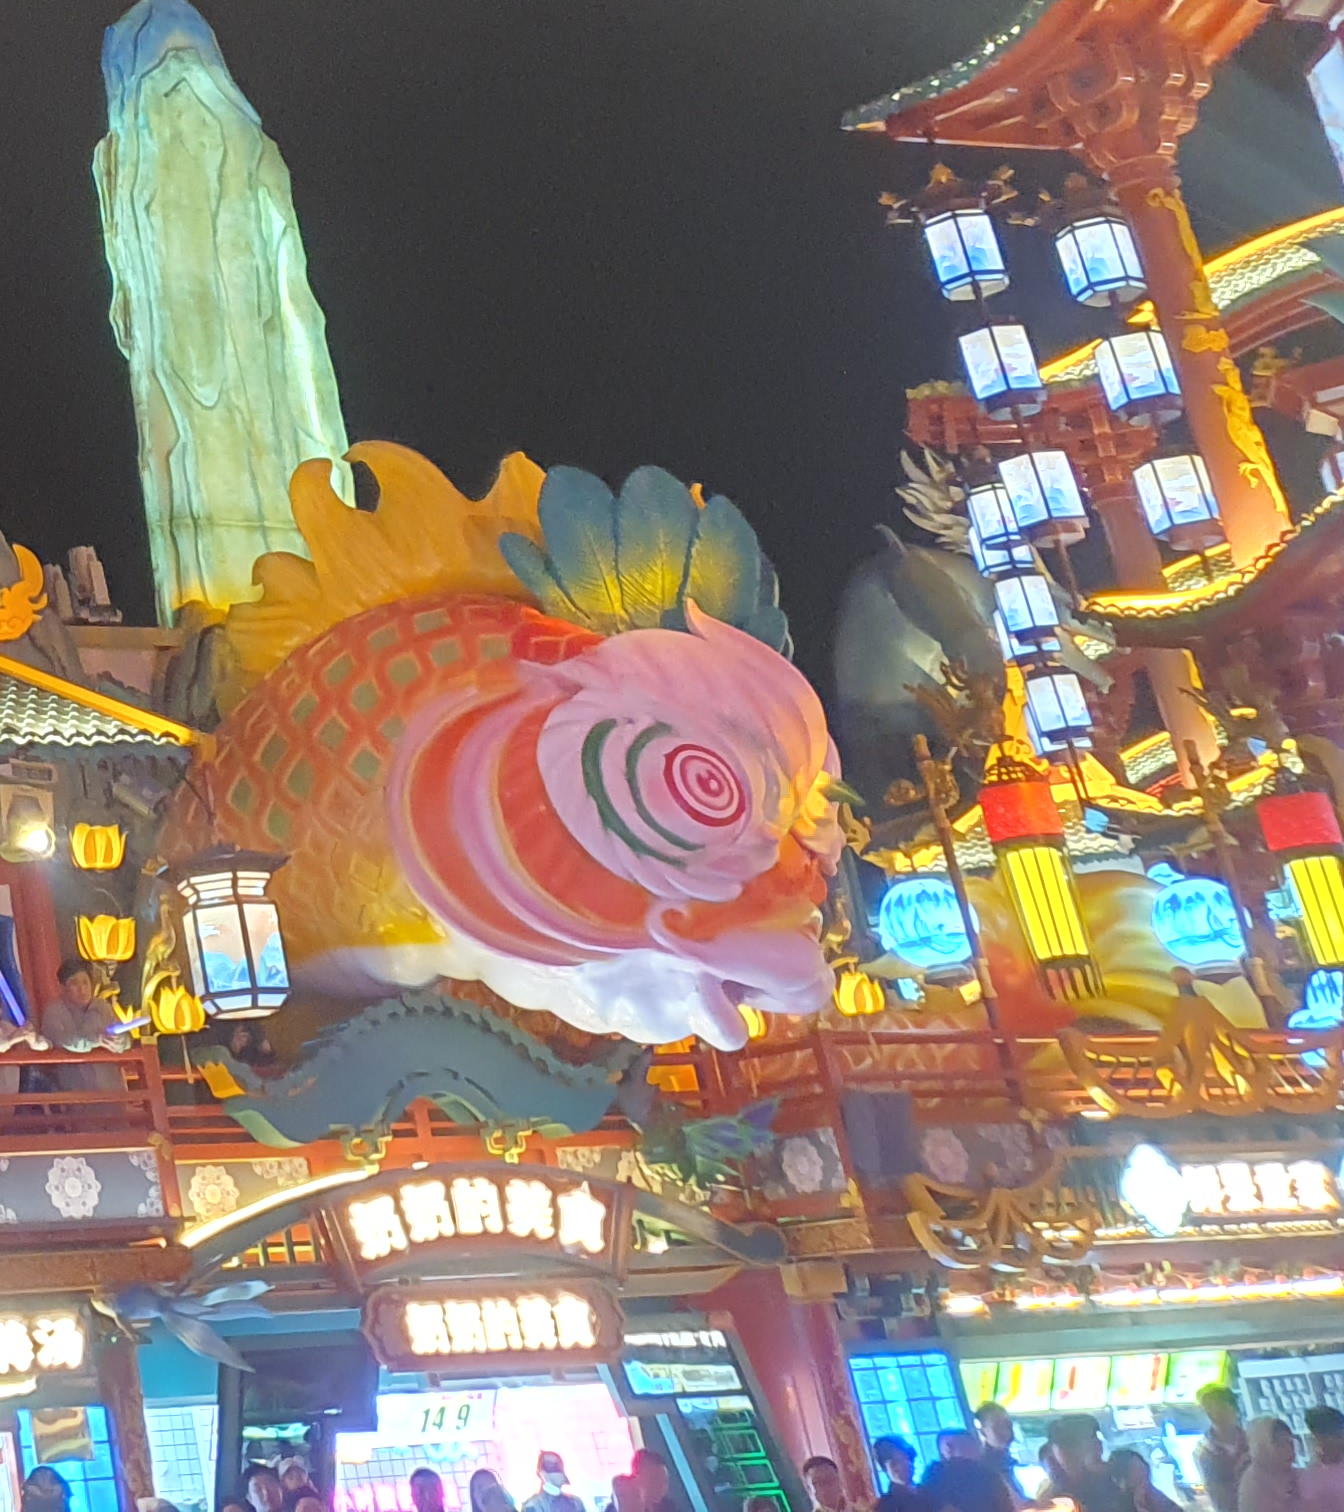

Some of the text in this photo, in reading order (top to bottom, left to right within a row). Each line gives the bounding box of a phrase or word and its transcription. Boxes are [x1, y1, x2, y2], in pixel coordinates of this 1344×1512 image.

[349, 1178, 605, 1259] 奶奶的美食
